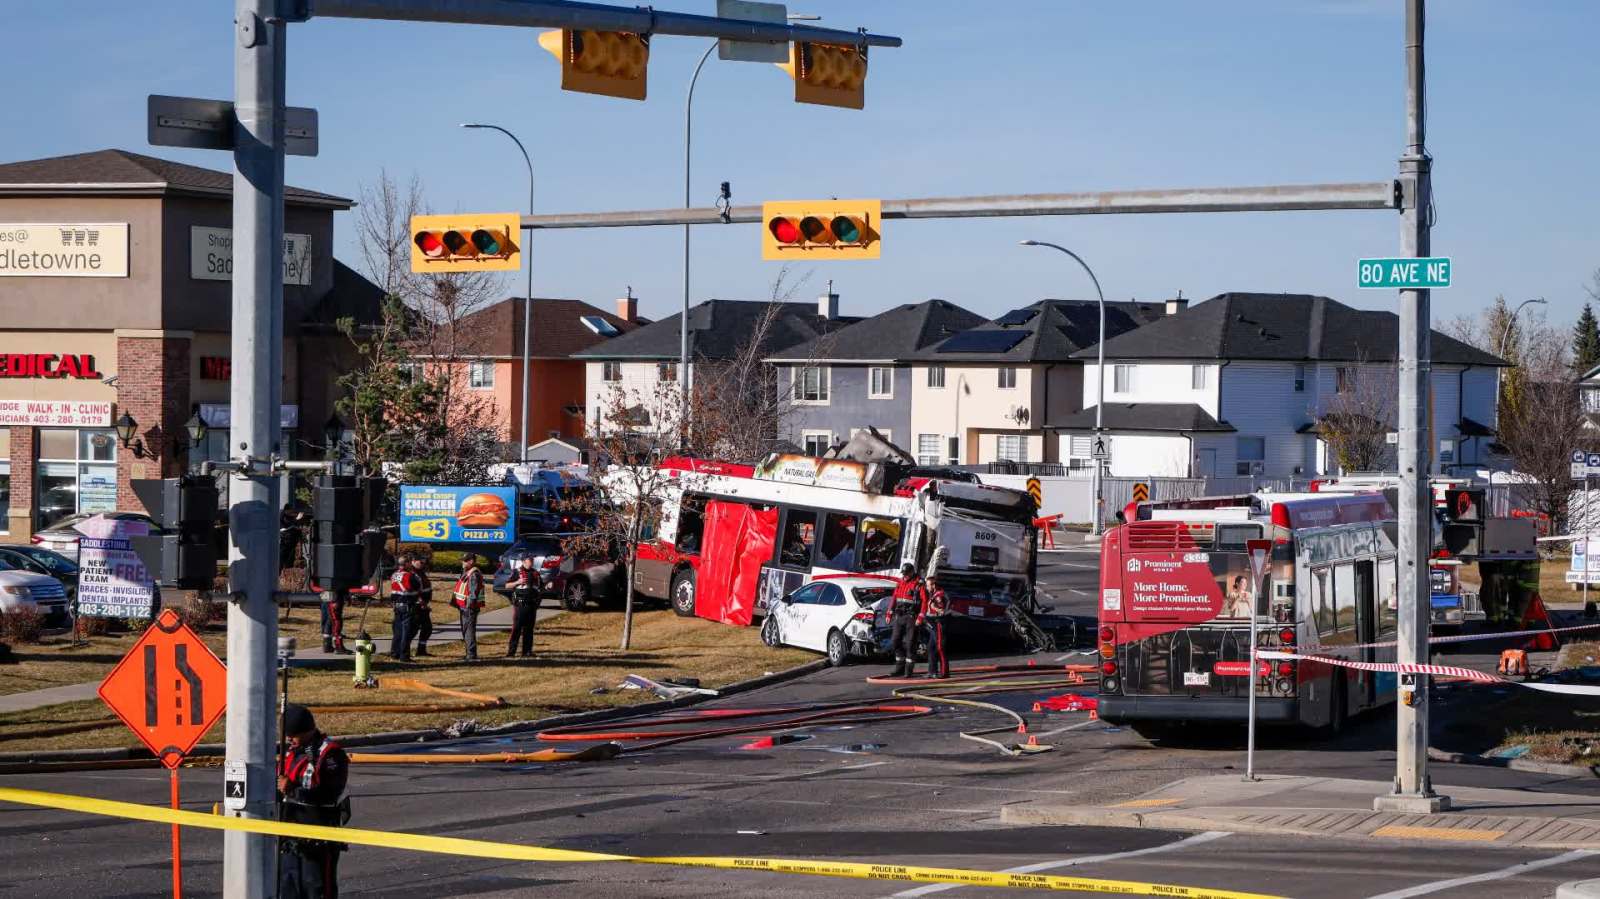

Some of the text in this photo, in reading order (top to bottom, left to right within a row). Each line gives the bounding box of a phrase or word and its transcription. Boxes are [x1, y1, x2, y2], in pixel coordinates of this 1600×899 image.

[0, 249, 101, 269] dletowne
[1361, 262, 1448, 284] 80 AVE NE
[27, 403, 53, 414] WALK
[61, 404, 71, 414] IN
[79, 404, 109, 414] CLINIC
[33, 415, 49, 424] 403
[57, 415, 73, 424] 280
[81, 416, 102, 424] 0179
[405, 499, 456, 509] CHICKEN
[428, 521, 446, 538] $5
[975, 531, 997, 541] 8609
[88, 559, 107, 568] NEW
[1144, 560, 1182, 568] Prominent
[80, 567, 113, 576] PATIENT
[84, 574, 109, 583] EXAM
[80, 584, 109, 594] BRACES
[1134, 582, 1189, 592] More Home.
[81, 594, 148, 606] DENTAL IMPLANTS
[1134, 593, 1211, 603] More Prominent.
[78, 603, 151, 618] 403-280-1122
[894, 866, 907, 874] LINE
[1152, 885, 1174, 893] POLICE
